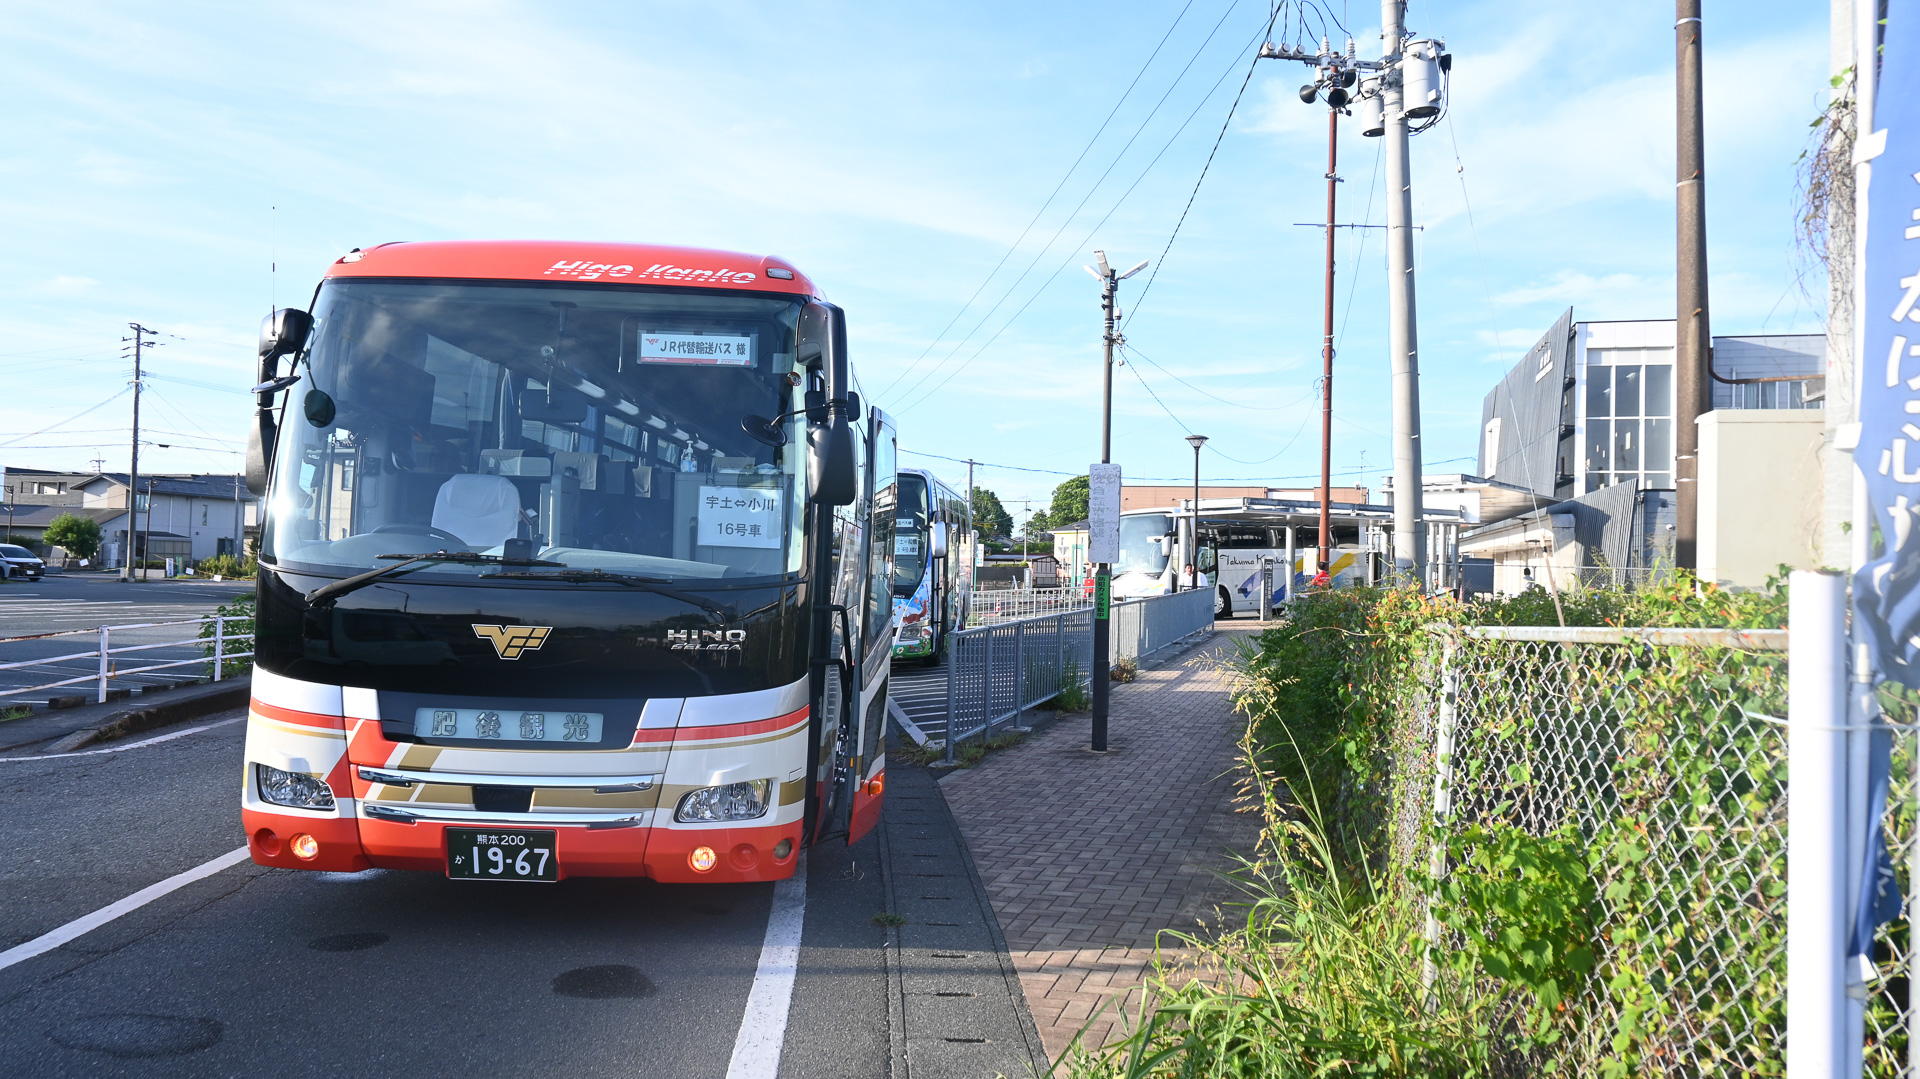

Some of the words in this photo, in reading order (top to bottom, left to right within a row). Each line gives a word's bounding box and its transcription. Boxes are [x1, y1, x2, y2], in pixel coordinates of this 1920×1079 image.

[544, 260, 633, 280] Higo
[638, 264, 756, 284] Kanko
[736, 343, 746, 355] 様
[717, 522, 761, 537] 16号車
[1219, 554, 1254, 566] Takuma
[667, 629, 746, 642] HINO
[431, 710, 589, 740] 肥後観光
[454, 855, 465, 865] か
[472, 846, 550, 876] 19-67
